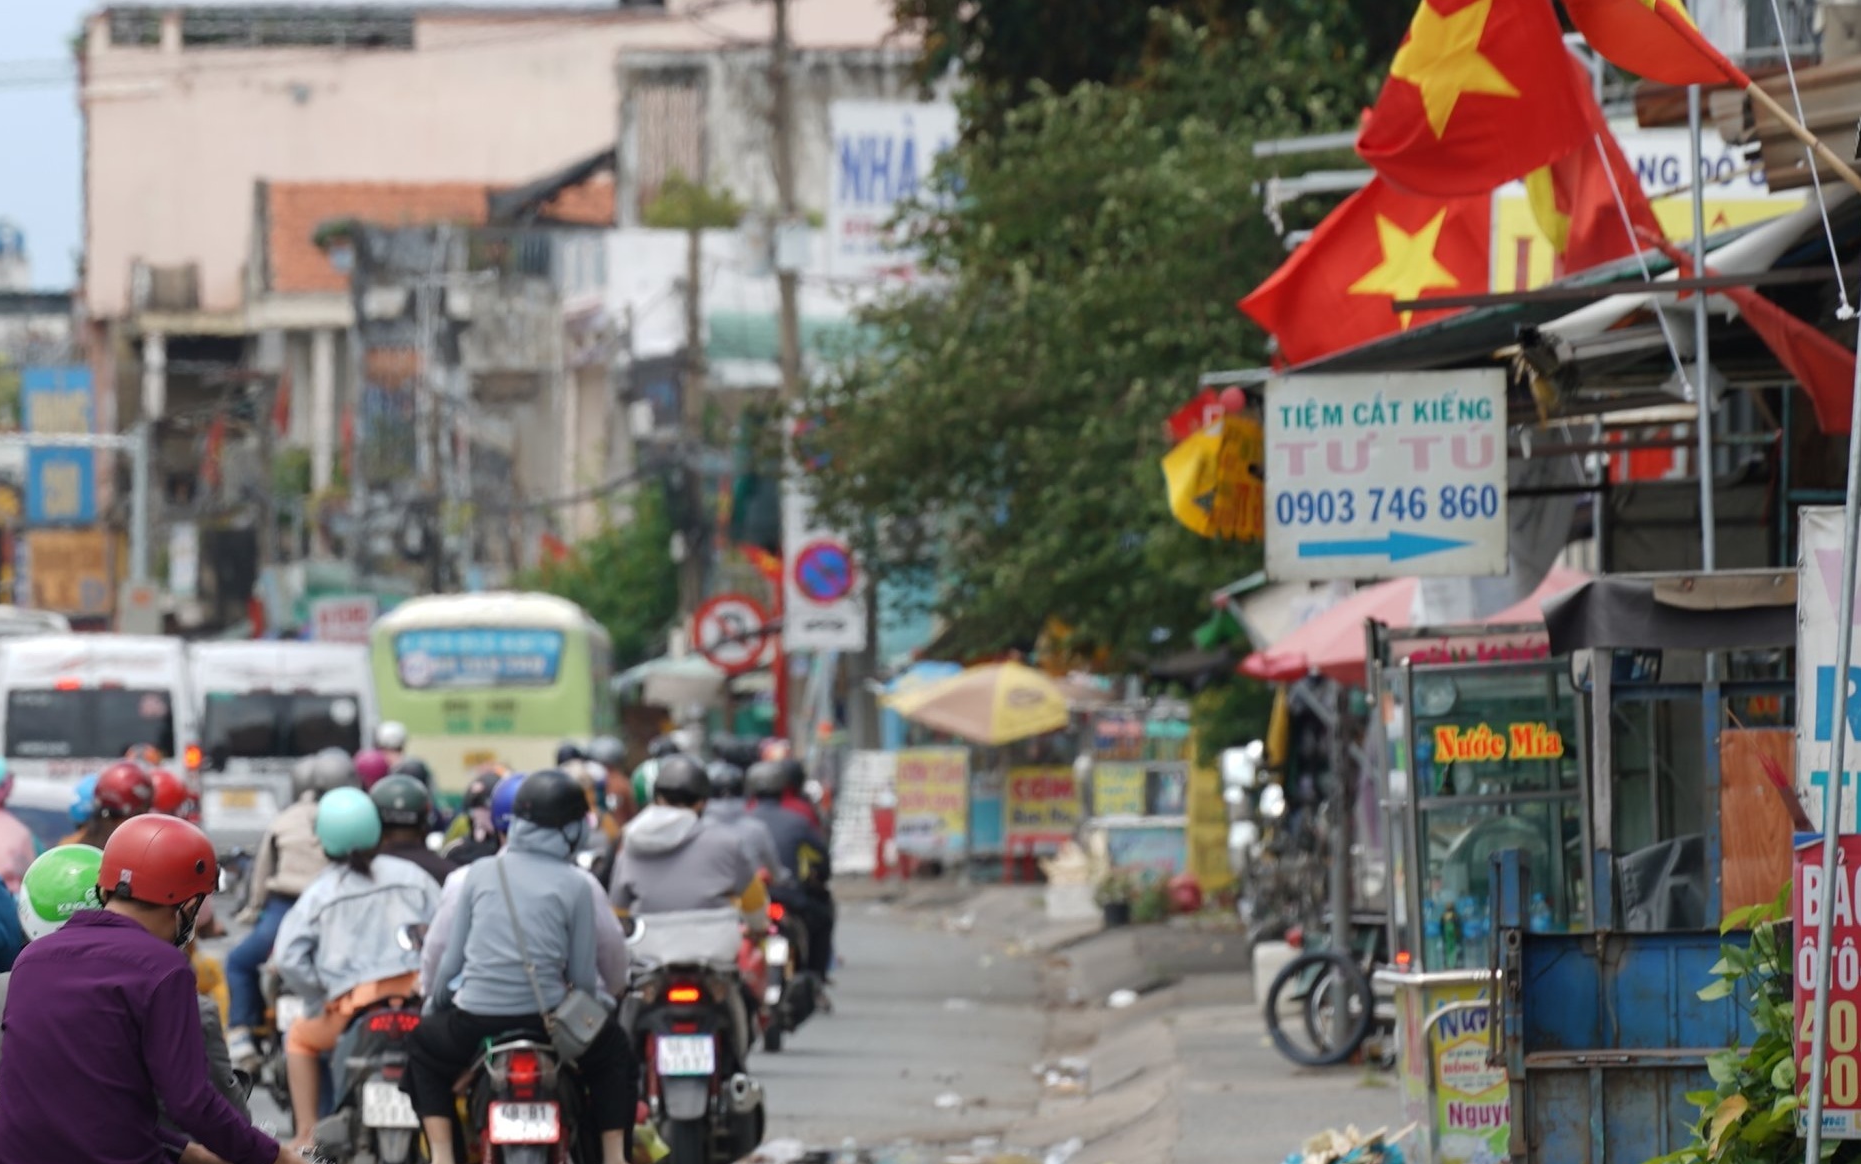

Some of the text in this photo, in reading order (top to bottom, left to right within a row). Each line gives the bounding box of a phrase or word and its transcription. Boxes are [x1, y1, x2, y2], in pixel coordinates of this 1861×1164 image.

[1279, 389, 1493, 432] TIỆM CẮT KIẾNG
[1275, 424, 1495, 477] TƯ TÚ
[1276, 483, 1498, 526] 0903 746 860
[1434, 721, 1565, 763] Nước Mía
[1449, 1100, 1510, 1131] Nguy
